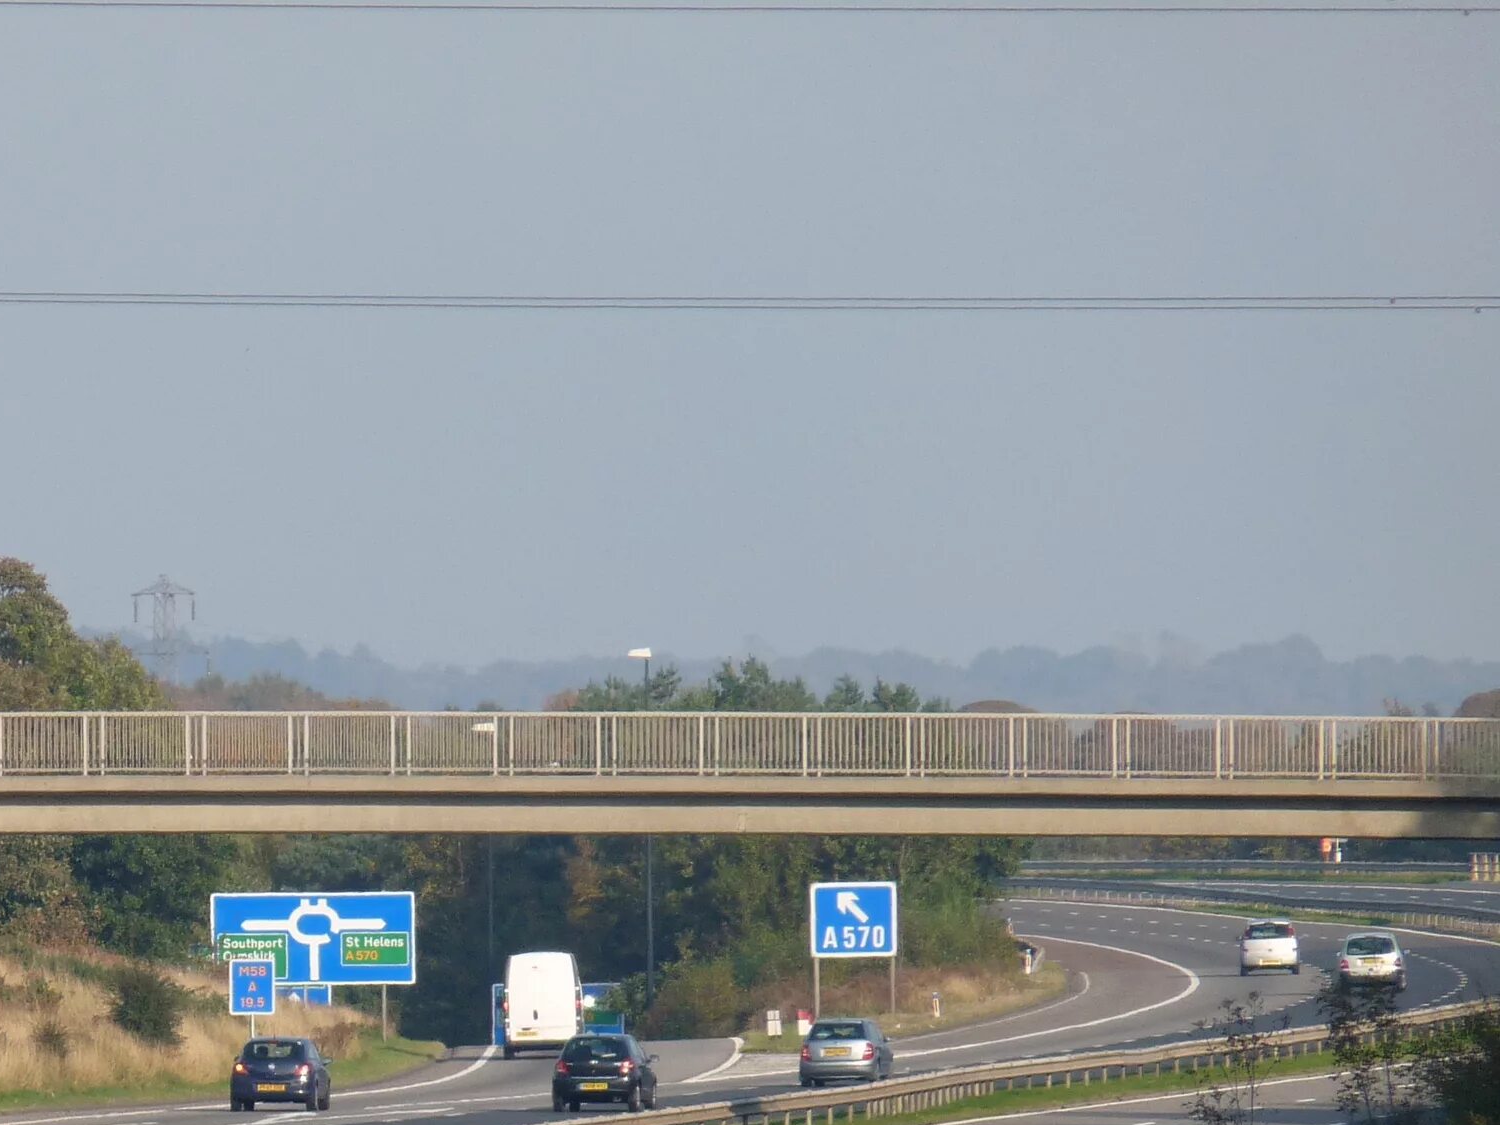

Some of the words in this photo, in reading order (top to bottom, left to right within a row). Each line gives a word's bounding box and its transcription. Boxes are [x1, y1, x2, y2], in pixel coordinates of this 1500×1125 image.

[223, 938, 283, 950] Southport
[346, 936, 360, 948] St
[364, 936, 404, 948] Helens
[239, 966, 267, 977] M58
[247, 981, 258, 992] A
